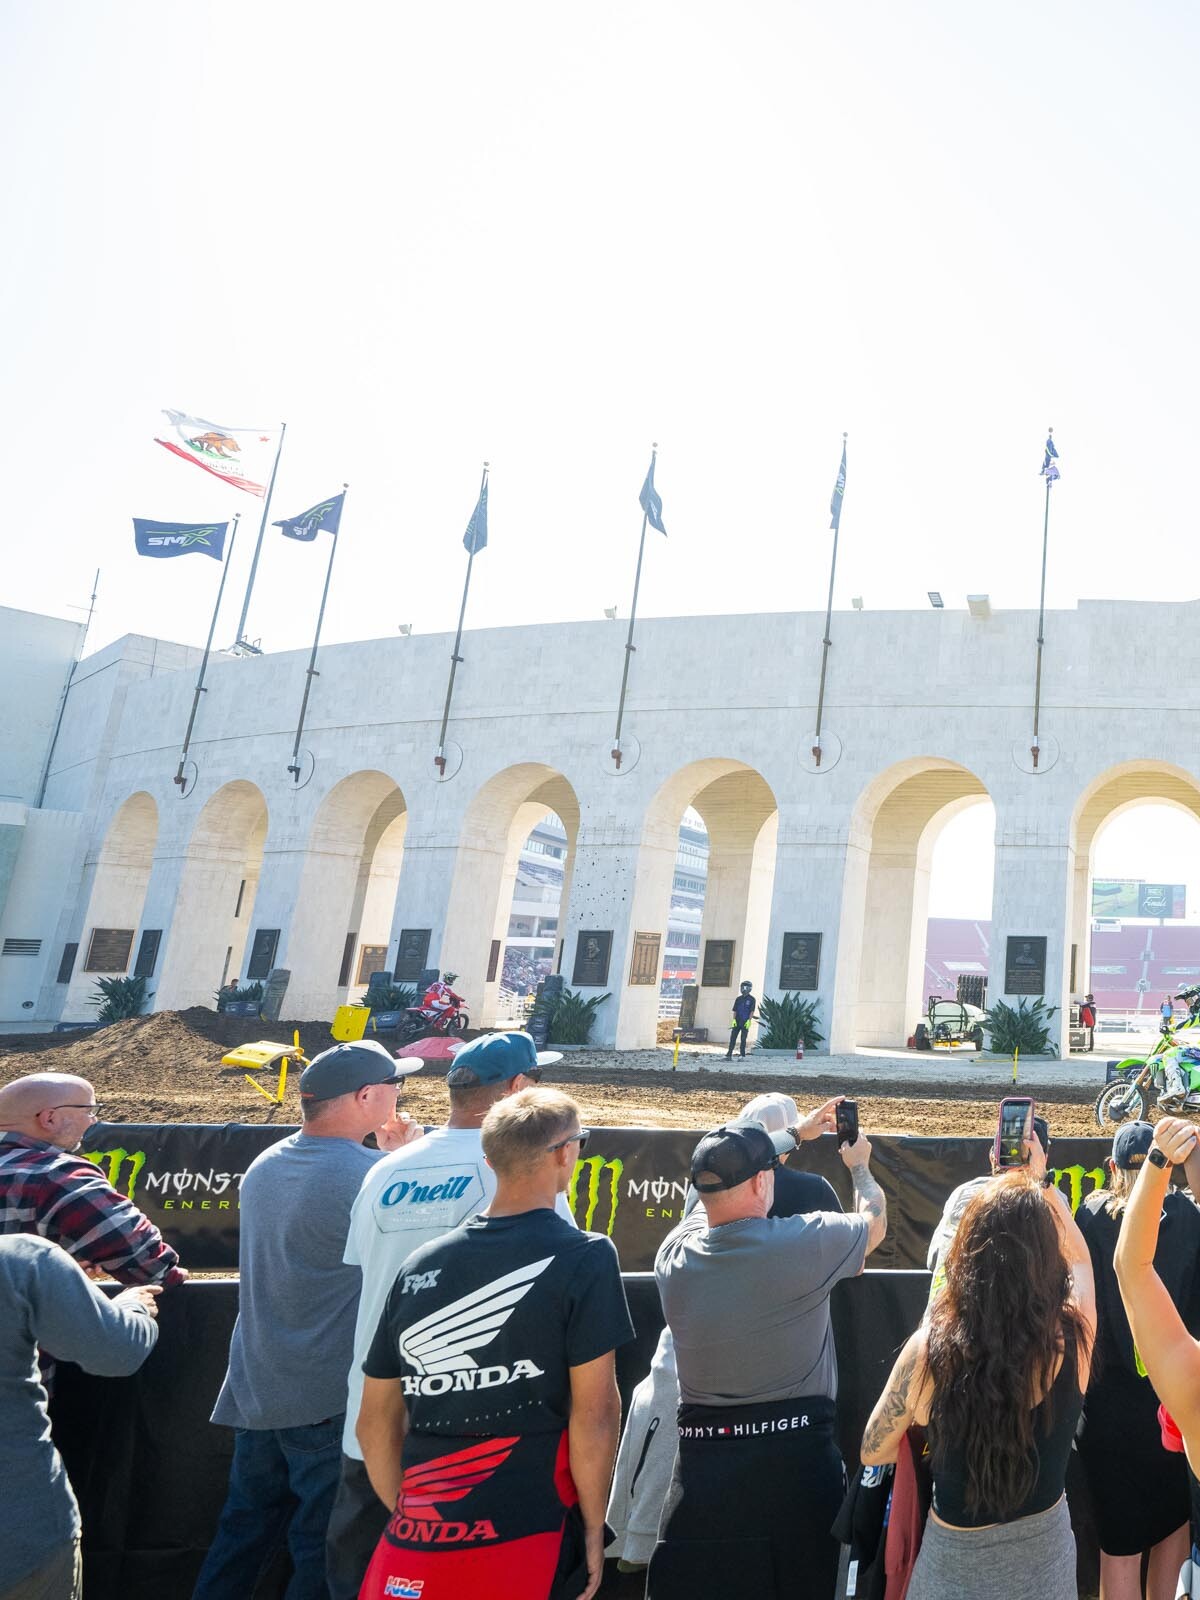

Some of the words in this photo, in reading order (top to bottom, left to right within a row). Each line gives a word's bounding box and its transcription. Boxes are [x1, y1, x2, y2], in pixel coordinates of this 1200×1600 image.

[147, 527, 219, 547] SMX
[382, 1176, 474, 1206] O'neill
[164, 1200, 240, 1210] ENER
[401, 1269, 442, 1295] FOX
[401, 1359, 545, 1396] HONDA
[733, 1415, 810, 1436] HILFIGER
[384, 1575, 424, 1599] HRC
